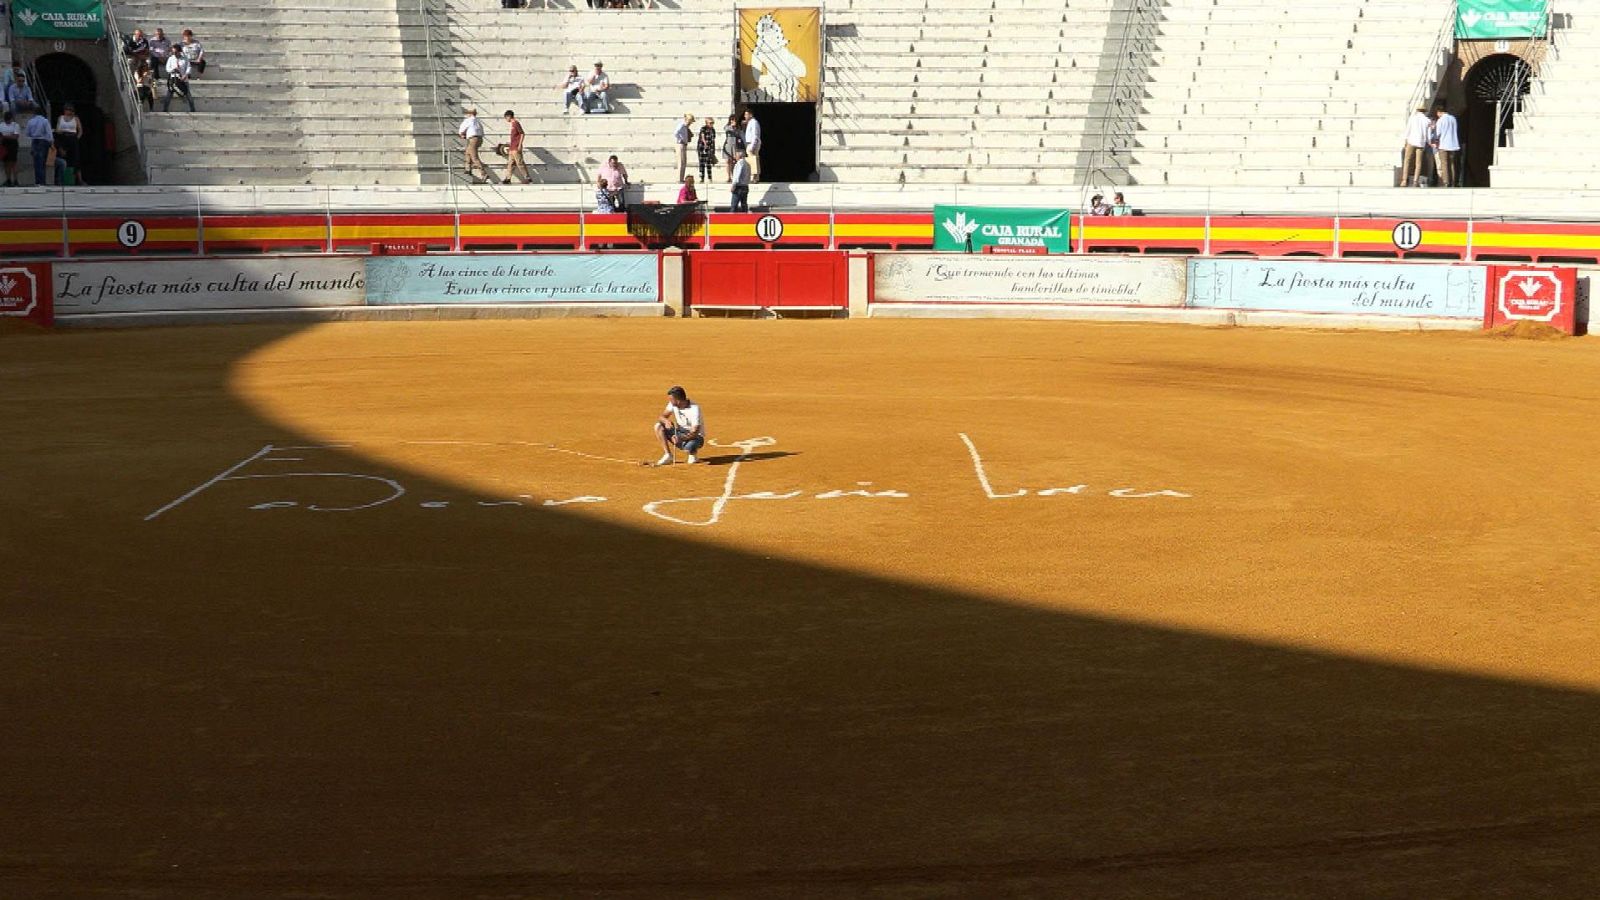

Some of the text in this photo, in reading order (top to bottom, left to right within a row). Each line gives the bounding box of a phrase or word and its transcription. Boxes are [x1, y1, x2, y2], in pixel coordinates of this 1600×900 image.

[67, 13, 100, 23] RURAL
[126, 224, 137, 243] 9
[763, 218, 776, 237] 10
[982, 224, 1062, 238] CAJA RURAL
[1400, 226, 1413, 245] 11
[998, 237, 1045, 246] GRANADA
[418, 262, 437, 279] A
[438, 264, 456, 277] las
[458, 266, 489, 277] cinco
[491, 264, 506, 277] de
[507, 263, 521, 277] la
[963, 266, 1014, 278] tremendo
[57, 270, 366, 305] La fiesta más culta del mundo
[443, 280, 478, 296] Eran
[481, 282, 499, 294] las
[501, 283, 532, 294] cinco
[535, 286, 548, 294] en
[548, 284, 587, 298] punto
[590, 282, 604, 294] de
[606, 281, 618, 294] la
[1258, 267, 1415, 294] La fiesta más culta
[1351, 290, 1434, 309] del mundo
